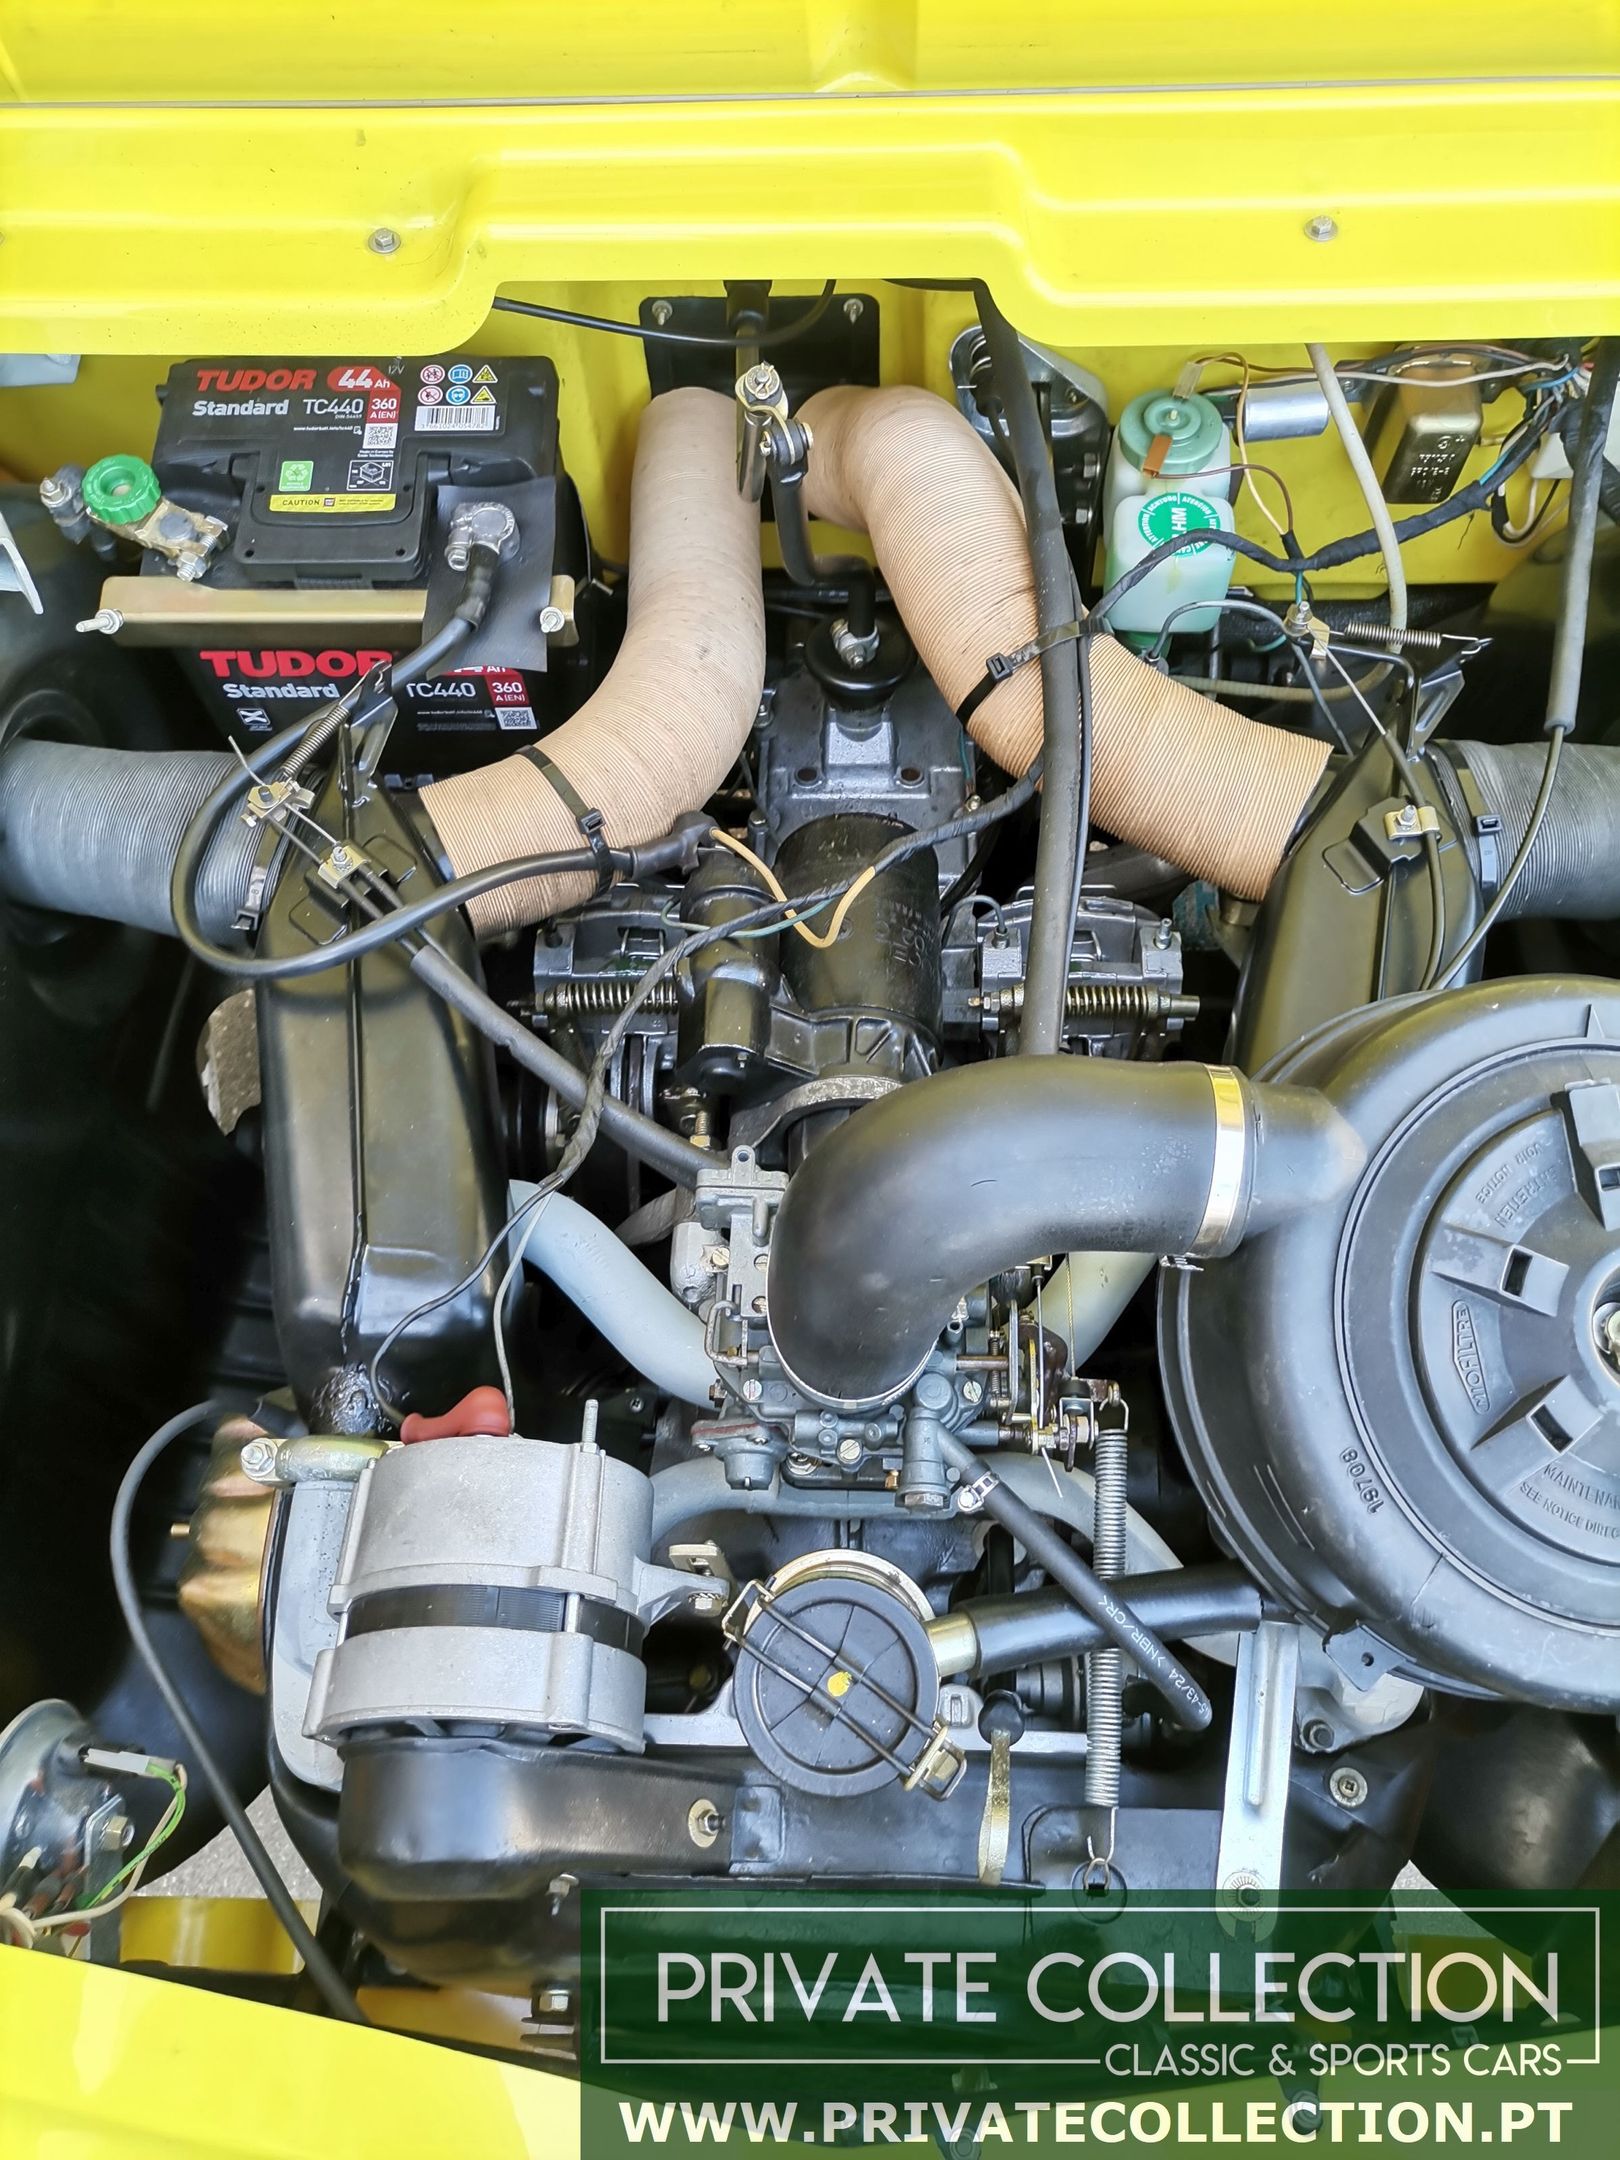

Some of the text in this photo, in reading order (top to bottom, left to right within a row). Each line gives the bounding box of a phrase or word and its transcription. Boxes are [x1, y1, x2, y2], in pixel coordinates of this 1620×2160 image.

[196, 368, 317, 392] TUDOR
[337, 368, 390, 389] 44 Ah
[192, 398, 363, 417] Standard TC440
[371, 398, 397, 411] 360
[370, 411, 396, 420] A (EN)
[222, 683, 340, 699] Standard
[492, 682, 523, 693] 360
